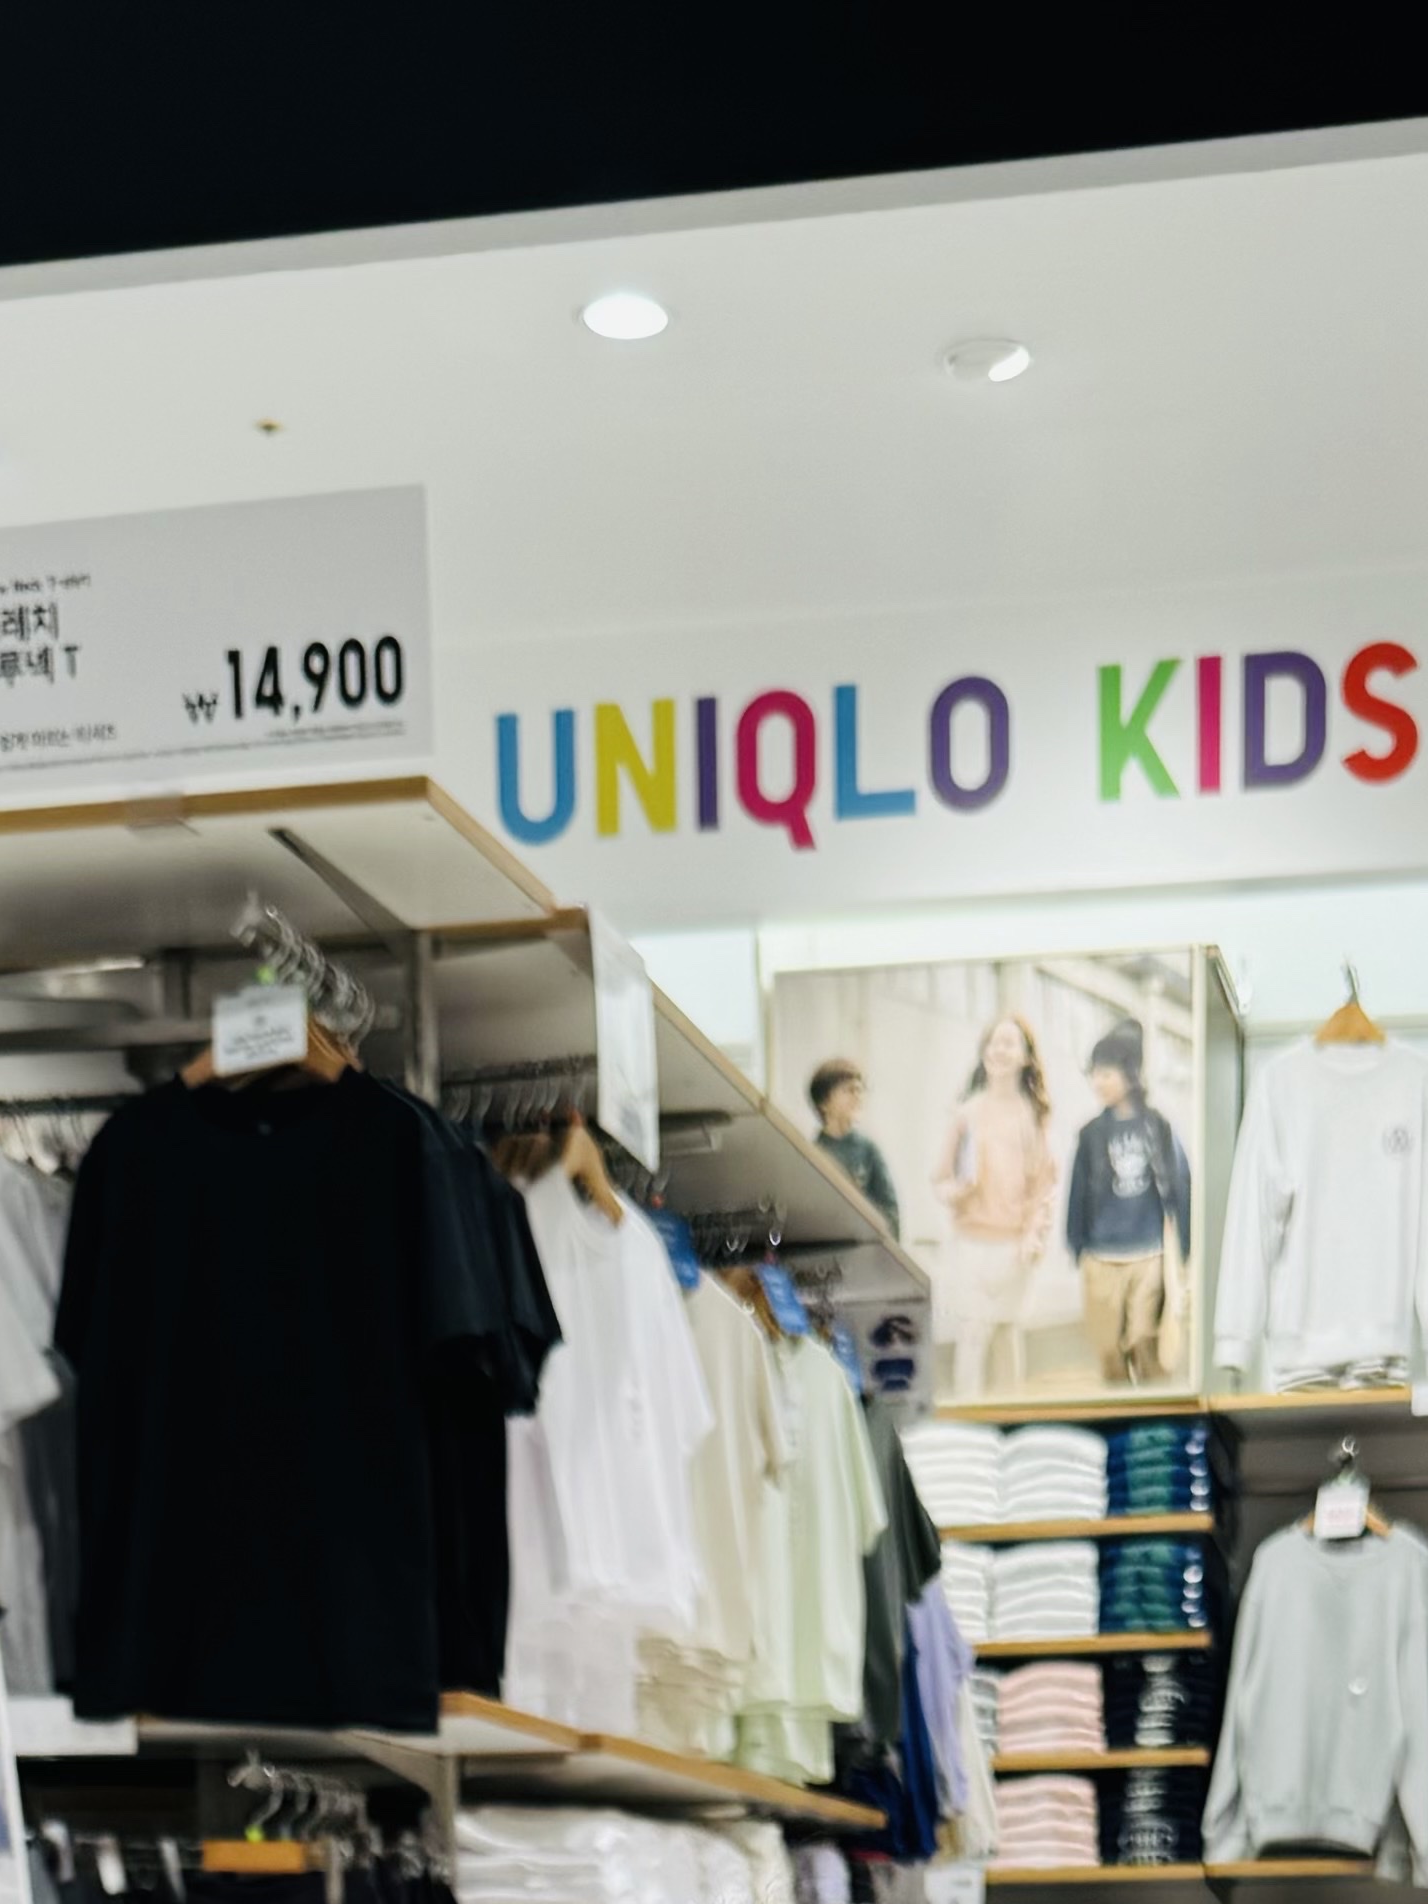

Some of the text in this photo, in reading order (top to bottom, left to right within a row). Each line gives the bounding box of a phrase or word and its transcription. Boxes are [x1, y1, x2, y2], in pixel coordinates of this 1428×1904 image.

[63, 645, 79, 678] T
[496, 674, 1012, 851] UNIQLO
[1096, 640, 1423, 804] KIDS
